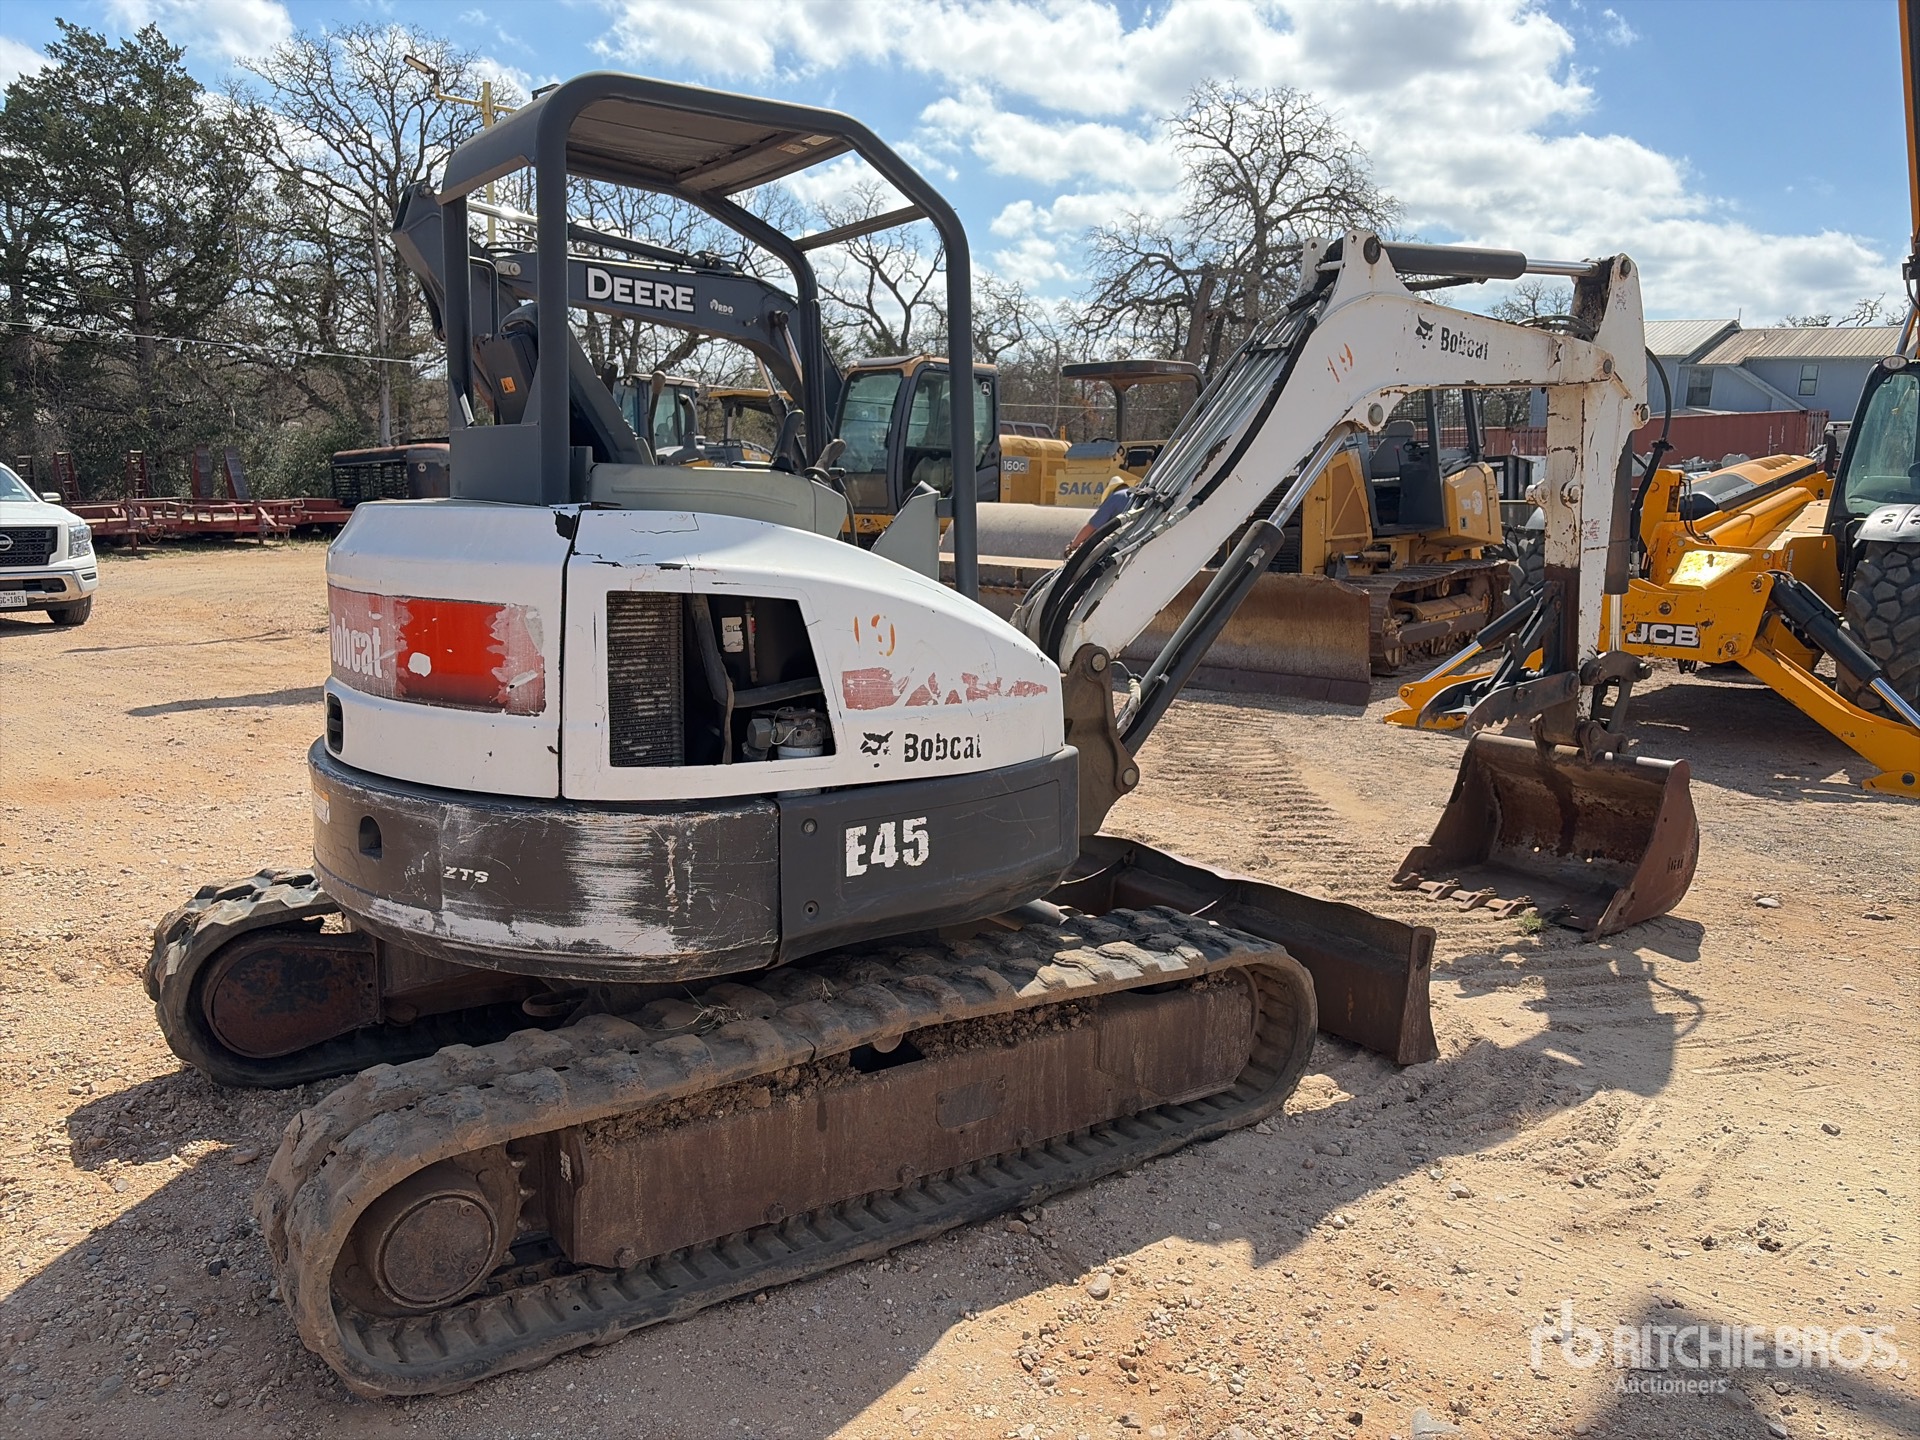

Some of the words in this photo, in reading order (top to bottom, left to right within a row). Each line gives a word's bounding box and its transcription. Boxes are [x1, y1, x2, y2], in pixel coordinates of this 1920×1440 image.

[586, 266, 695, 313] DEERE
[1003, 460, 1025, 472] 160G
[1058, 481, 1109, 495] SAKA
[330, 612, 383, 679] Bobcat
[1627, 623, 1700, 646] JCB
[904, 732, 981, 763] Bobcat
[845, 816, 929, 877] E45
[443, 865, 489, 883] ZTS
